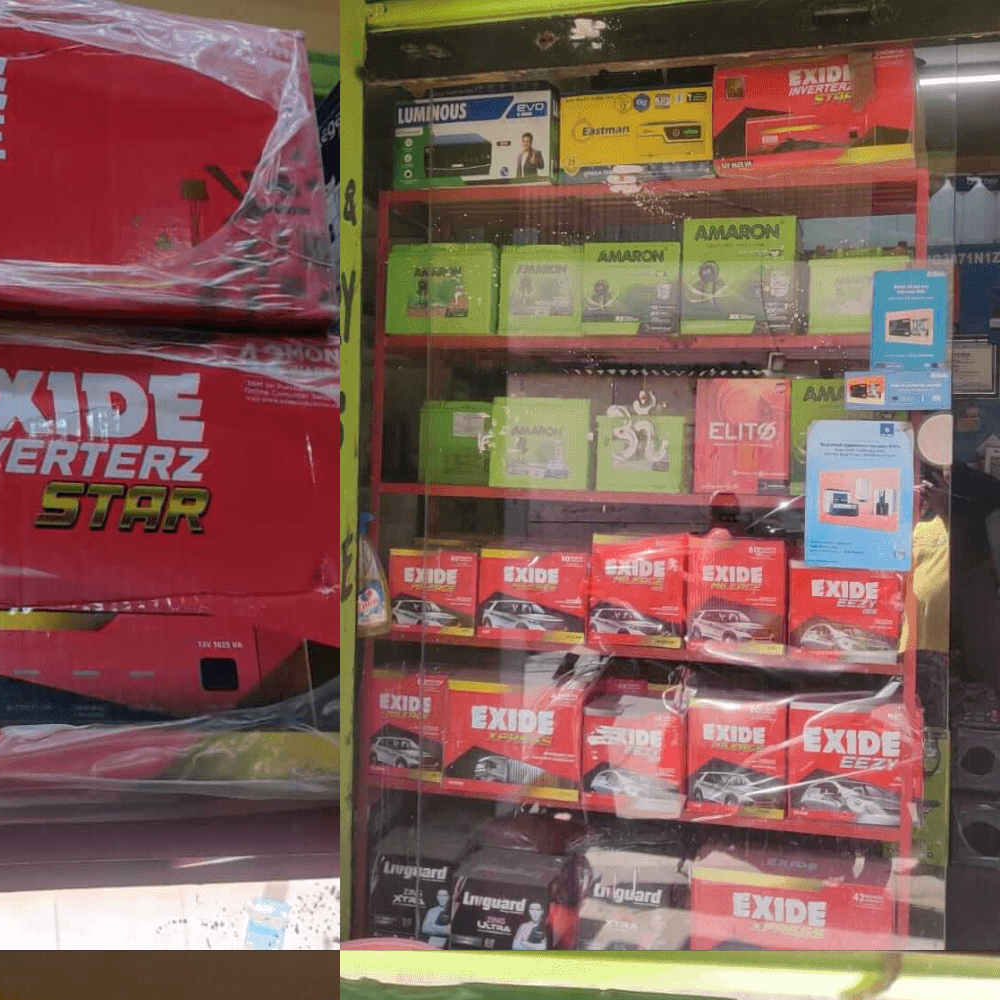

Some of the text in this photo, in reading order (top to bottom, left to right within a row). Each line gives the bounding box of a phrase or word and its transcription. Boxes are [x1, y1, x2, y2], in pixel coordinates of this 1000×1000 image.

[397, 102, 468, 125] LUMINOUS
[516, 102, 544, 113] evo
[582, 125, 630, 137] Eastman
[694, 223, 781, 242] AMARON
[598, 250, 664, 262] AMARON
[32, 480, 212, 533] STAR
[404, 567, 458, 585] EXIDE
[504, 566, 560, 585] EXIDE
[604, 557, 666, 578] EXIDE
[702, 565, 763, 583] EXIDE
[811, 579, 880, 600] EXIDE
[379, 693, 431, 714] EXIDE
[471, 706, 555, 735] EXIDE
[702, 723, 766, 745] EXIDE
[803, 727, 901, 758] EXIDE
[839, 757, 899, 770] EEZY
[382, 860, 448, 882] Livguard
[462, 891, 527, 914] Livguard
[732, 892, 828, 928] EXIDE
